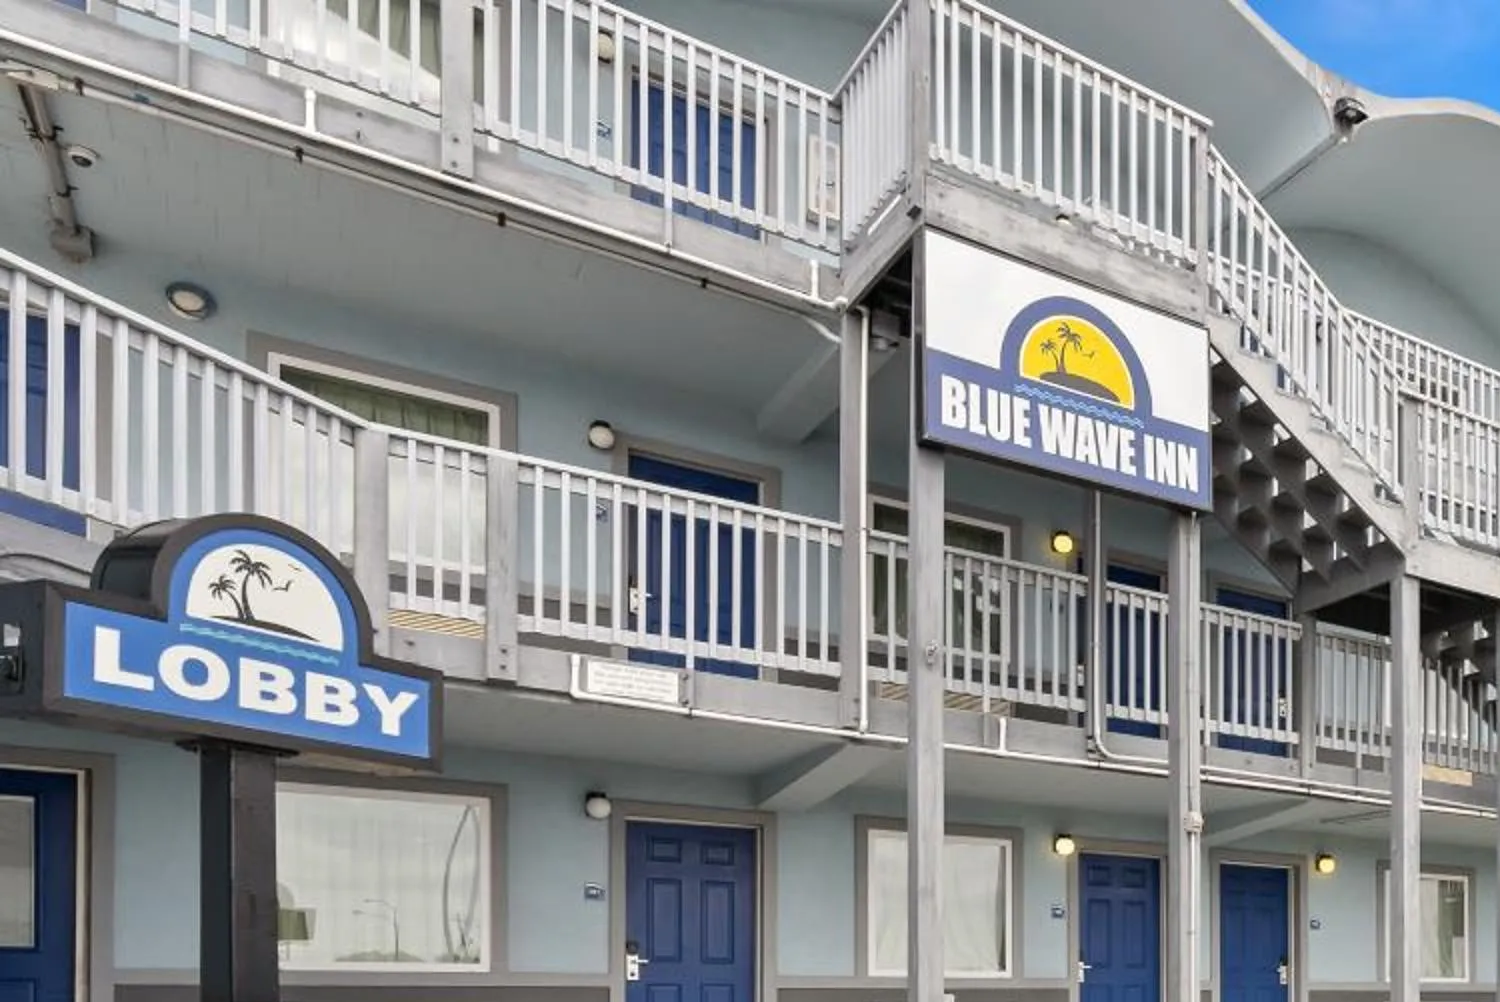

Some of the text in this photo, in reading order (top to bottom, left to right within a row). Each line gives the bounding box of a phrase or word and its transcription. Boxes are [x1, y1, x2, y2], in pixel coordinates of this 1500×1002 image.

[941, 375, 1199, 493] BLUE WAVE INN
[93, 625, 419, 737] LOBBY
